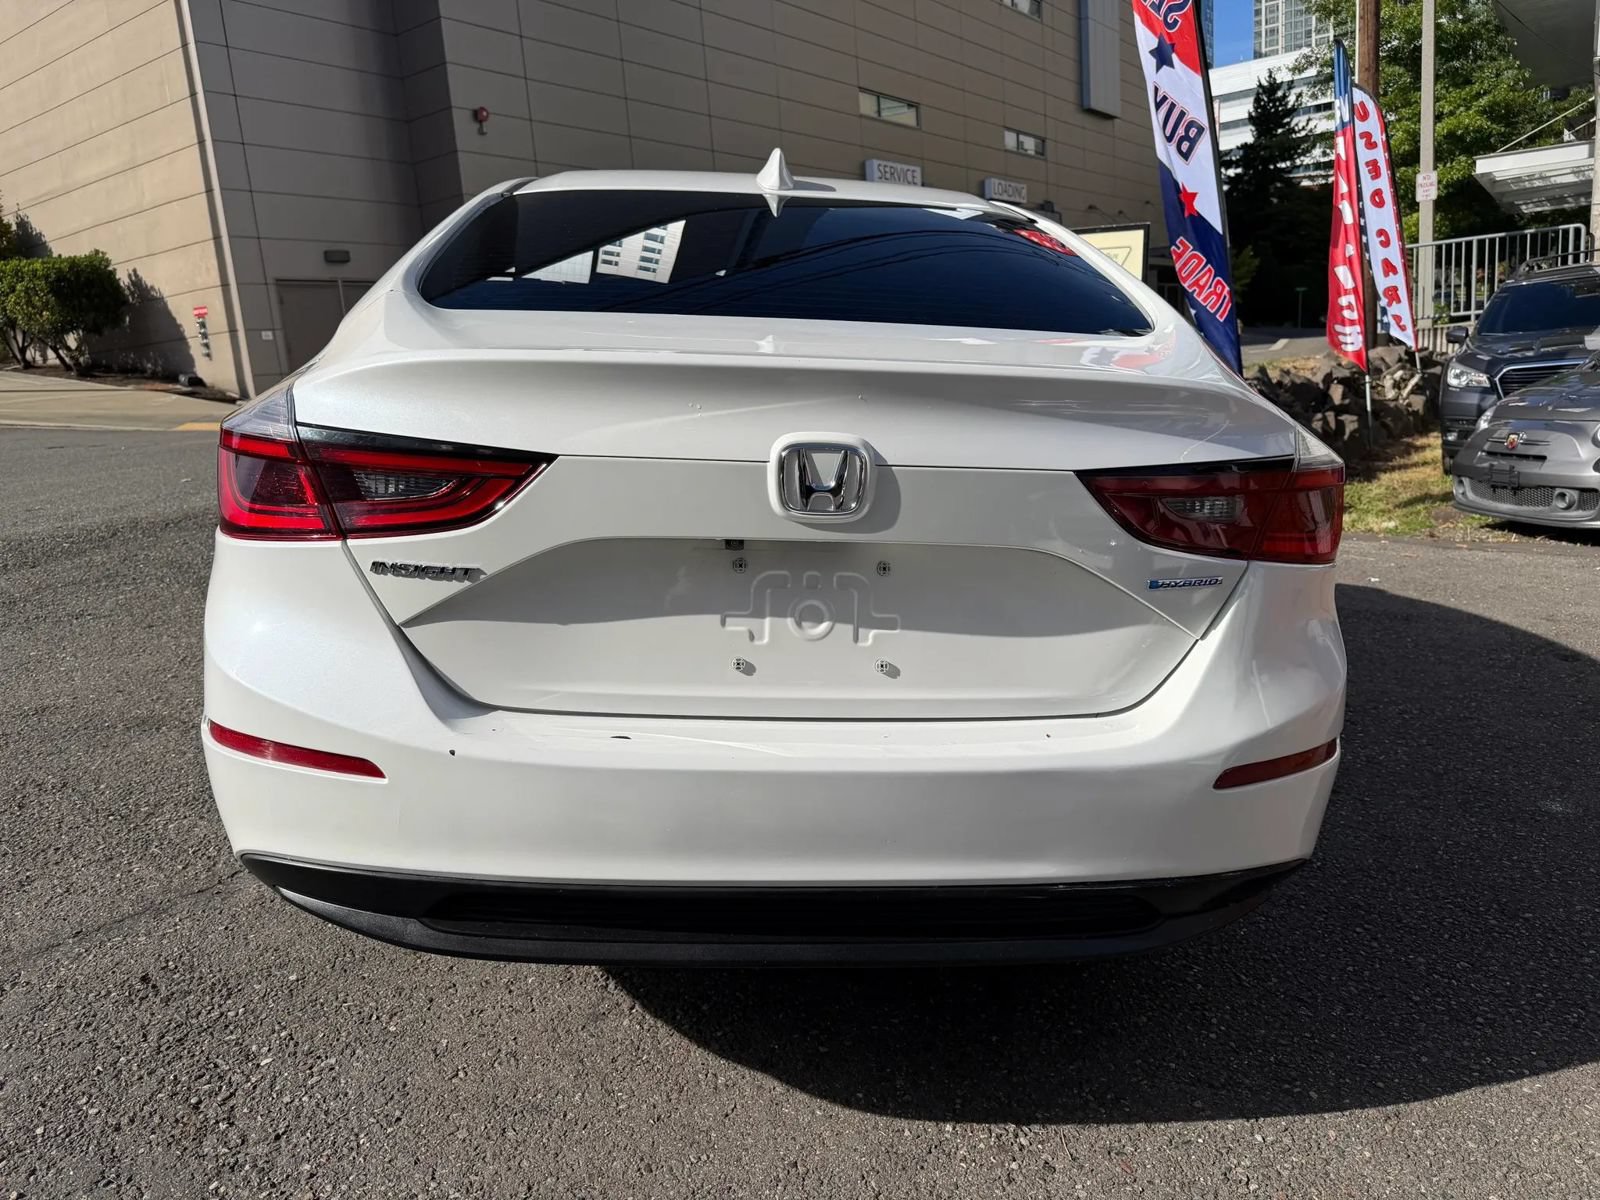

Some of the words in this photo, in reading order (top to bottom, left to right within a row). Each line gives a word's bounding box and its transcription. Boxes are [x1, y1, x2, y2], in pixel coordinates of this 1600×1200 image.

[877, 163, 918, 185] SERVICE
[370, 561, 481, 581] INSIGHT
[1160, 578, 1220, 589] HYBRID
